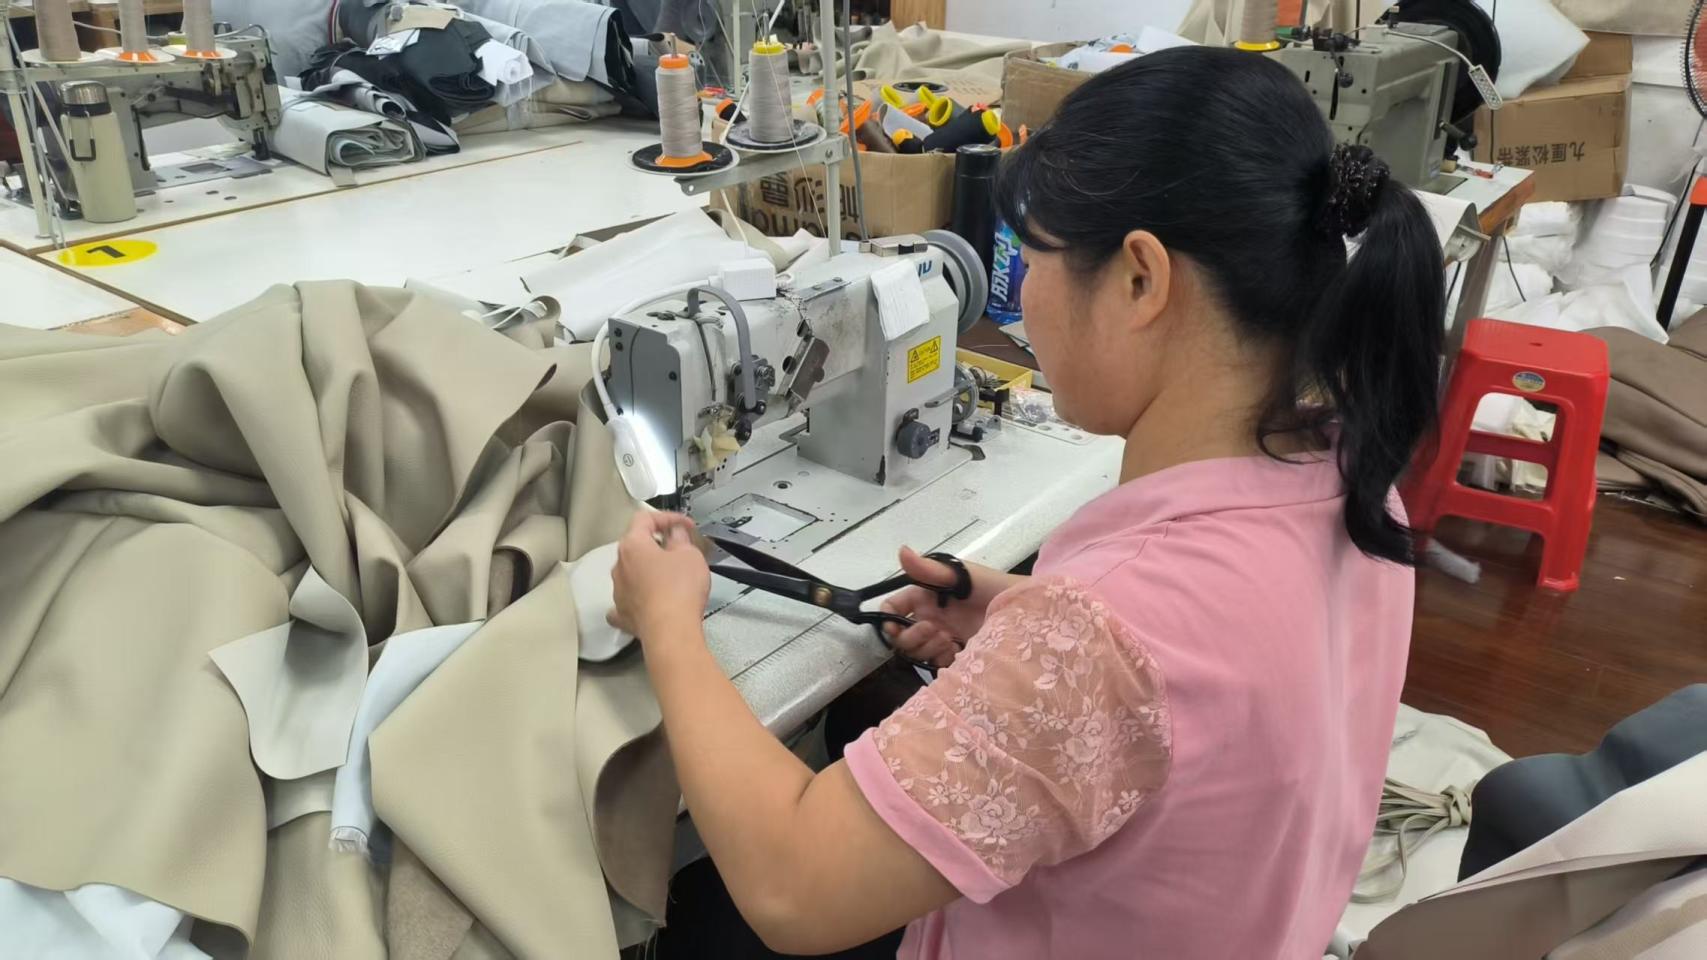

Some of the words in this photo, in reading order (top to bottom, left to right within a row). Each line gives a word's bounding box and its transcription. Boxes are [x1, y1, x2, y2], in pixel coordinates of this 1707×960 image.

[1497, 141, 1586, 167] 九厘松紧带
